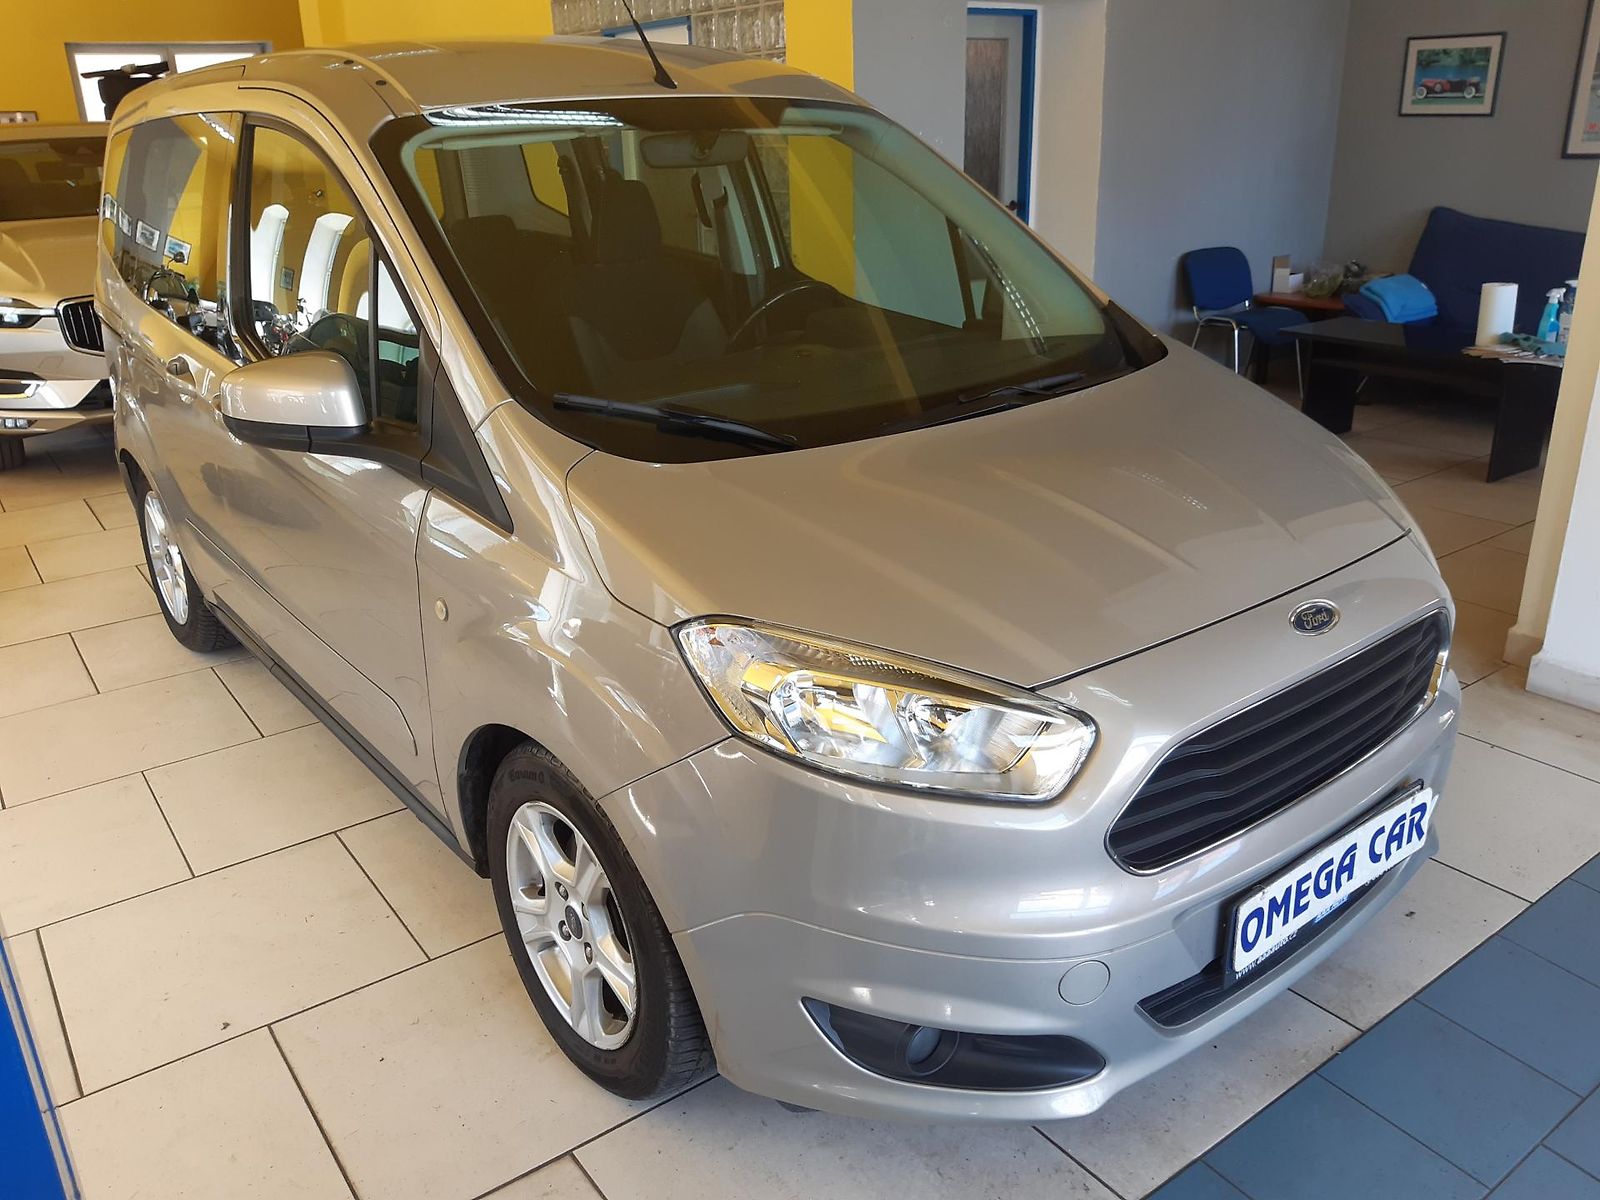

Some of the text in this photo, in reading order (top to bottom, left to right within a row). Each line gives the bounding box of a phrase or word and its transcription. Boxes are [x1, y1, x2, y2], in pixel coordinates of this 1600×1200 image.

[1301, 608, 1329, 630] Ford
[1240, 802, 1428, 954] OMEGA CAR
